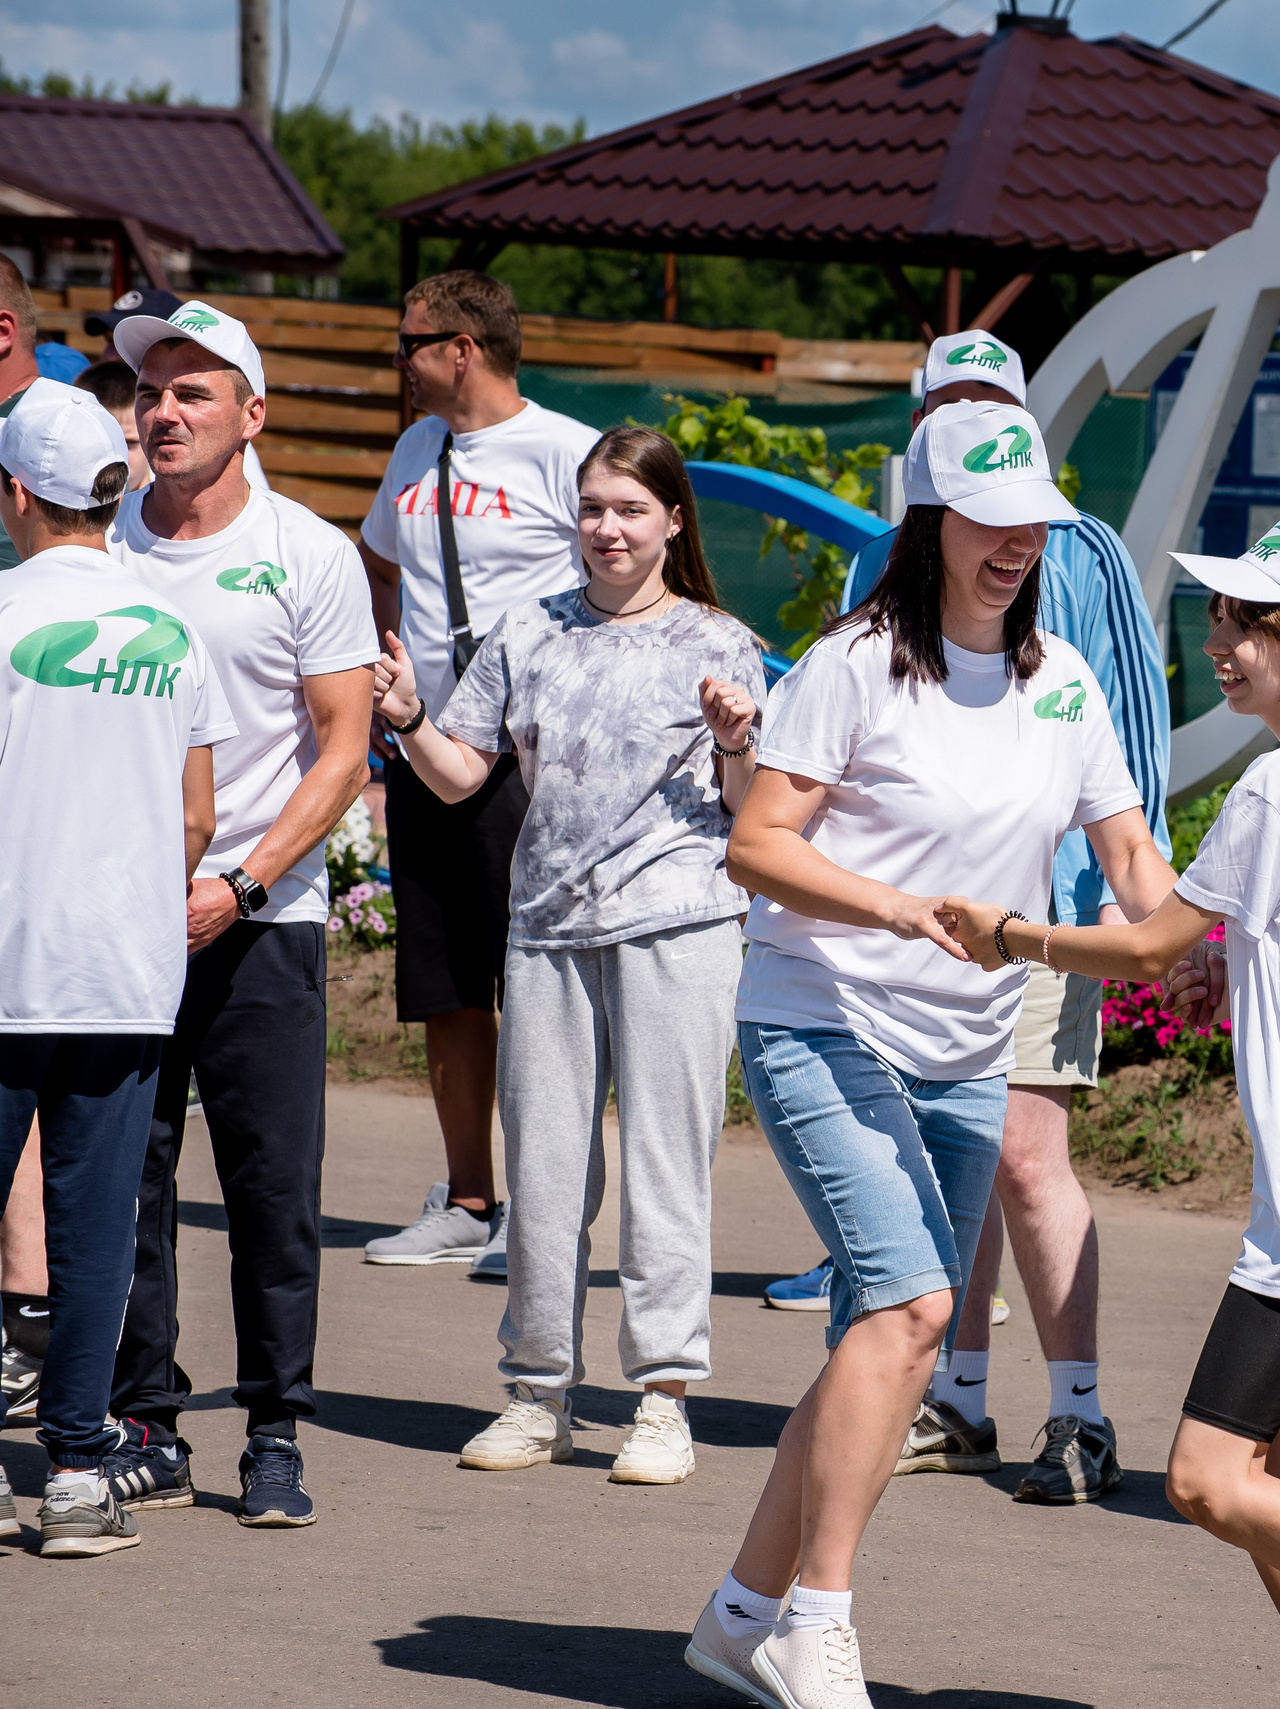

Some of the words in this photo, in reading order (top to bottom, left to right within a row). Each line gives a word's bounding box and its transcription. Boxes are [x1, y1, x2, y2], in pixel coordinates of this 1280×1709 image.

[970, 354, 1003, 373] НЛК
[1000, 451, 1034, 471] НЛК
[245, 580, 281, 598] НЛК
[92, 657, 182, 700] НЛК
